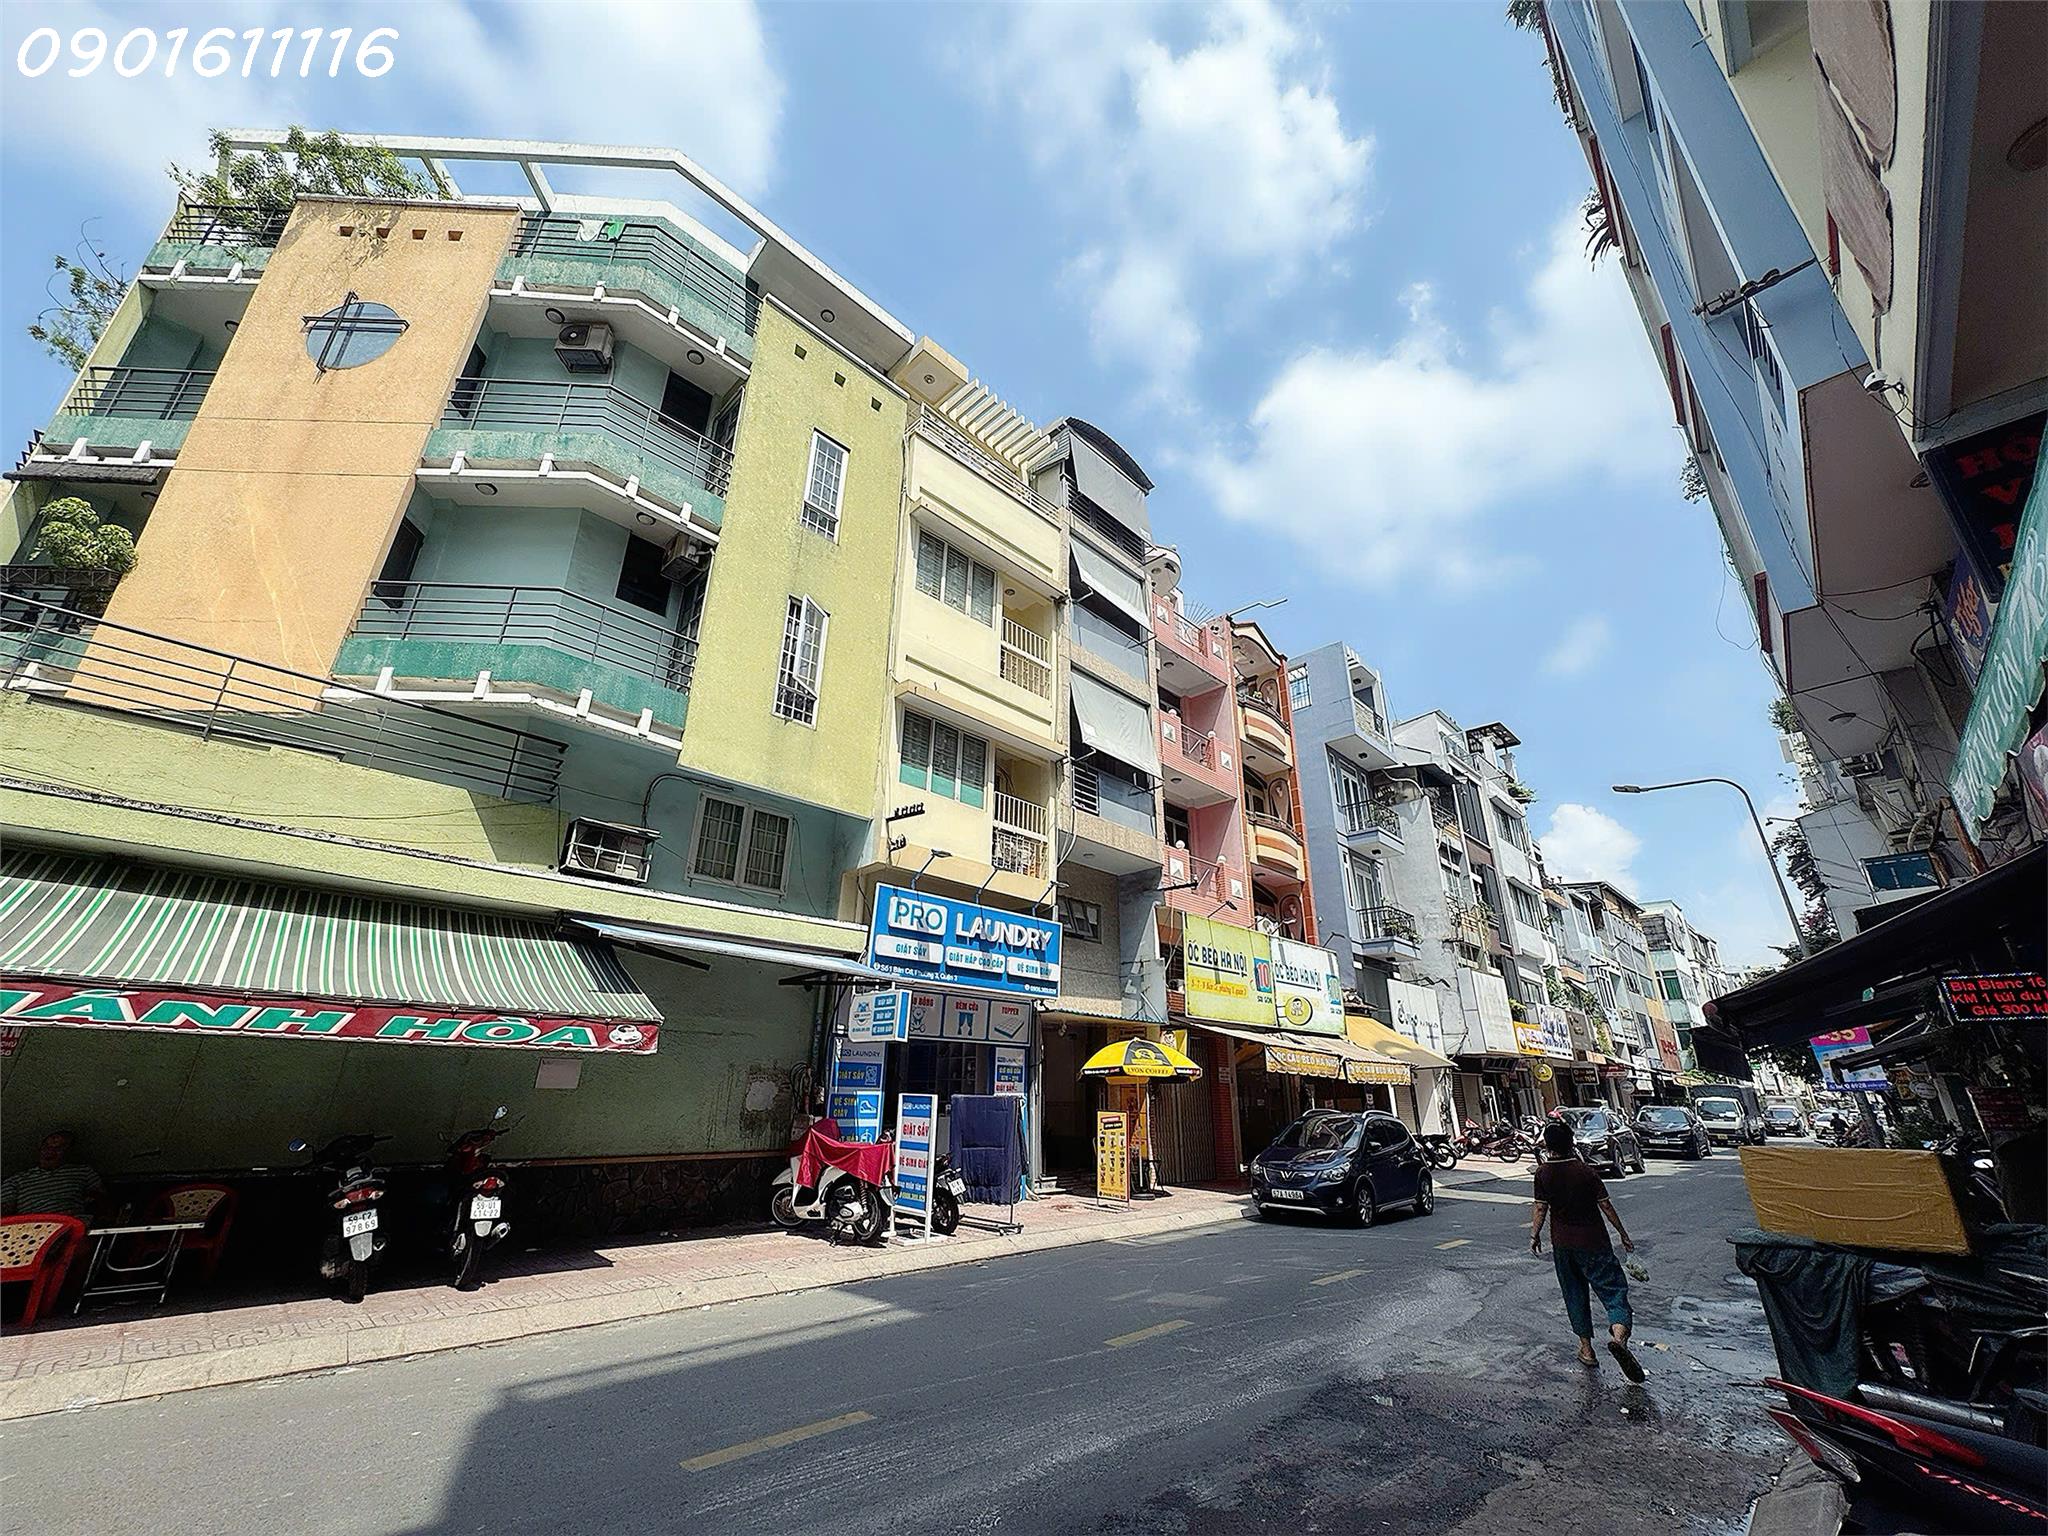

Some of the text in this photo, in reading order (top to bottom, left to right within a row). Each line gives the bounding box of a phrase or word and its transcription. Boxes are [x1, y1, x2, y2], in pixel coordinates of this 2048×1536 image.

[894, 900, 1053, 951] PRO LAUNDRY
[895, 943, 912, 954] GIẶT
[1202, 943, 1219, 966] BÉO
[1978, 979, 2024, 990] Blanc
[1952, 993, 1978, 1004] KM
[2001, 1003, 2031, 1014] 300
[375, 1007, 599, 1048] HÒA
[852, 1049, 881, 1057] LAUNDRY
[902, 1122, 916, 1138] GIẶT
[345, 1219, 377, 1236] 97869
